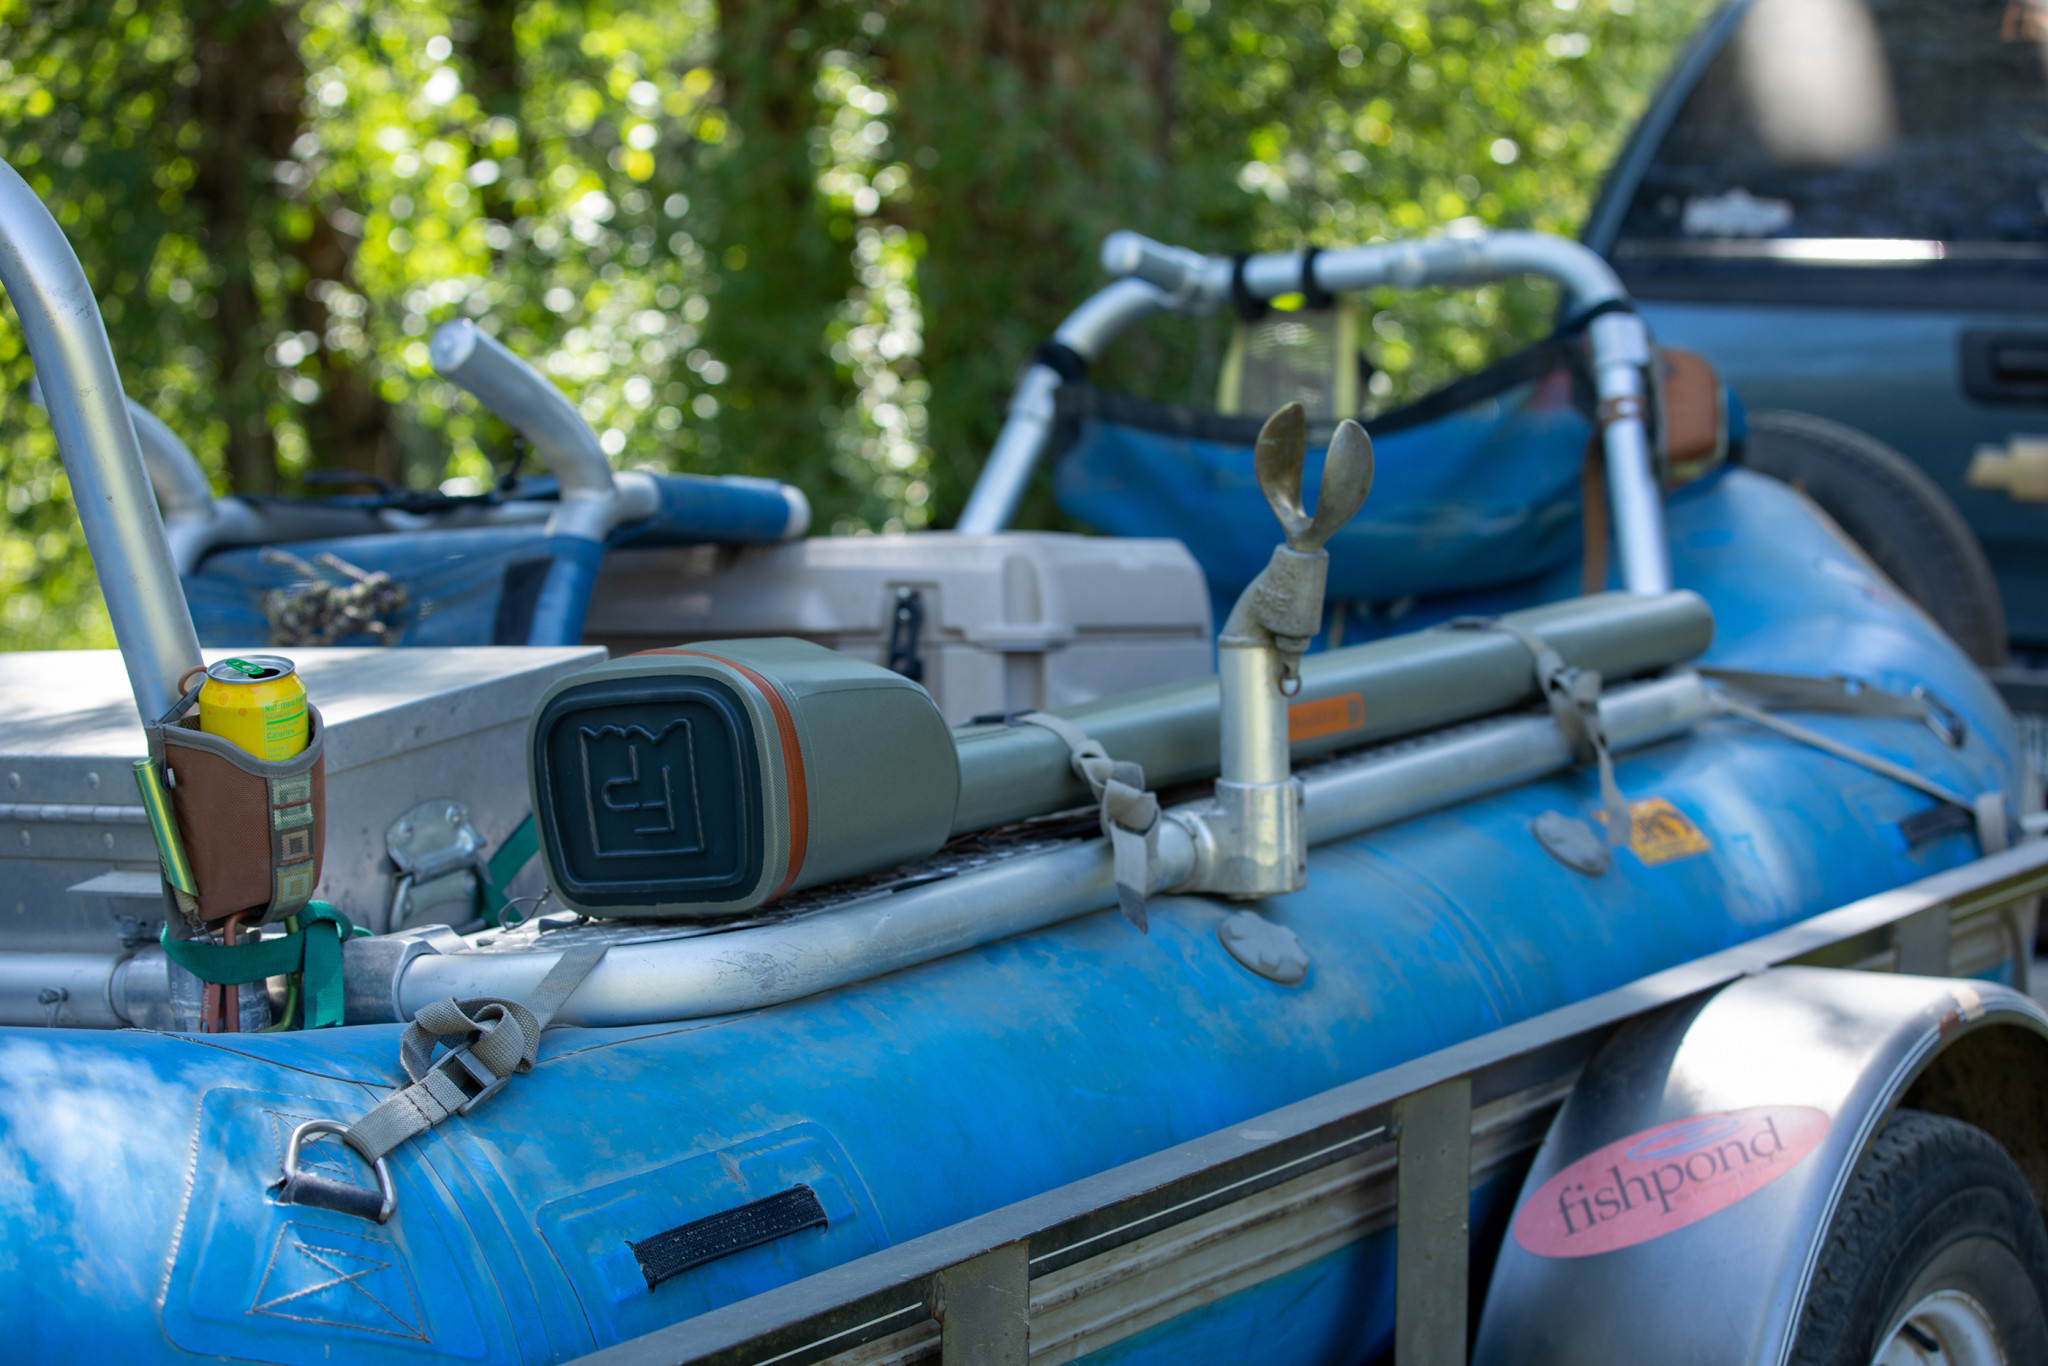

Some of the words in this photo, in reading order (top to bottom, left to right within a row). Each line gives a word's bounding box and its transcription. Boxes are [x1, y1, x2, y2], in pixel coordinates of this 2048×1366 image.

[264, 700, 294, 712] Nutrition
[266, 728, 295, 739] Calories
[1557, 1115, 1786, 1238] fishpond
